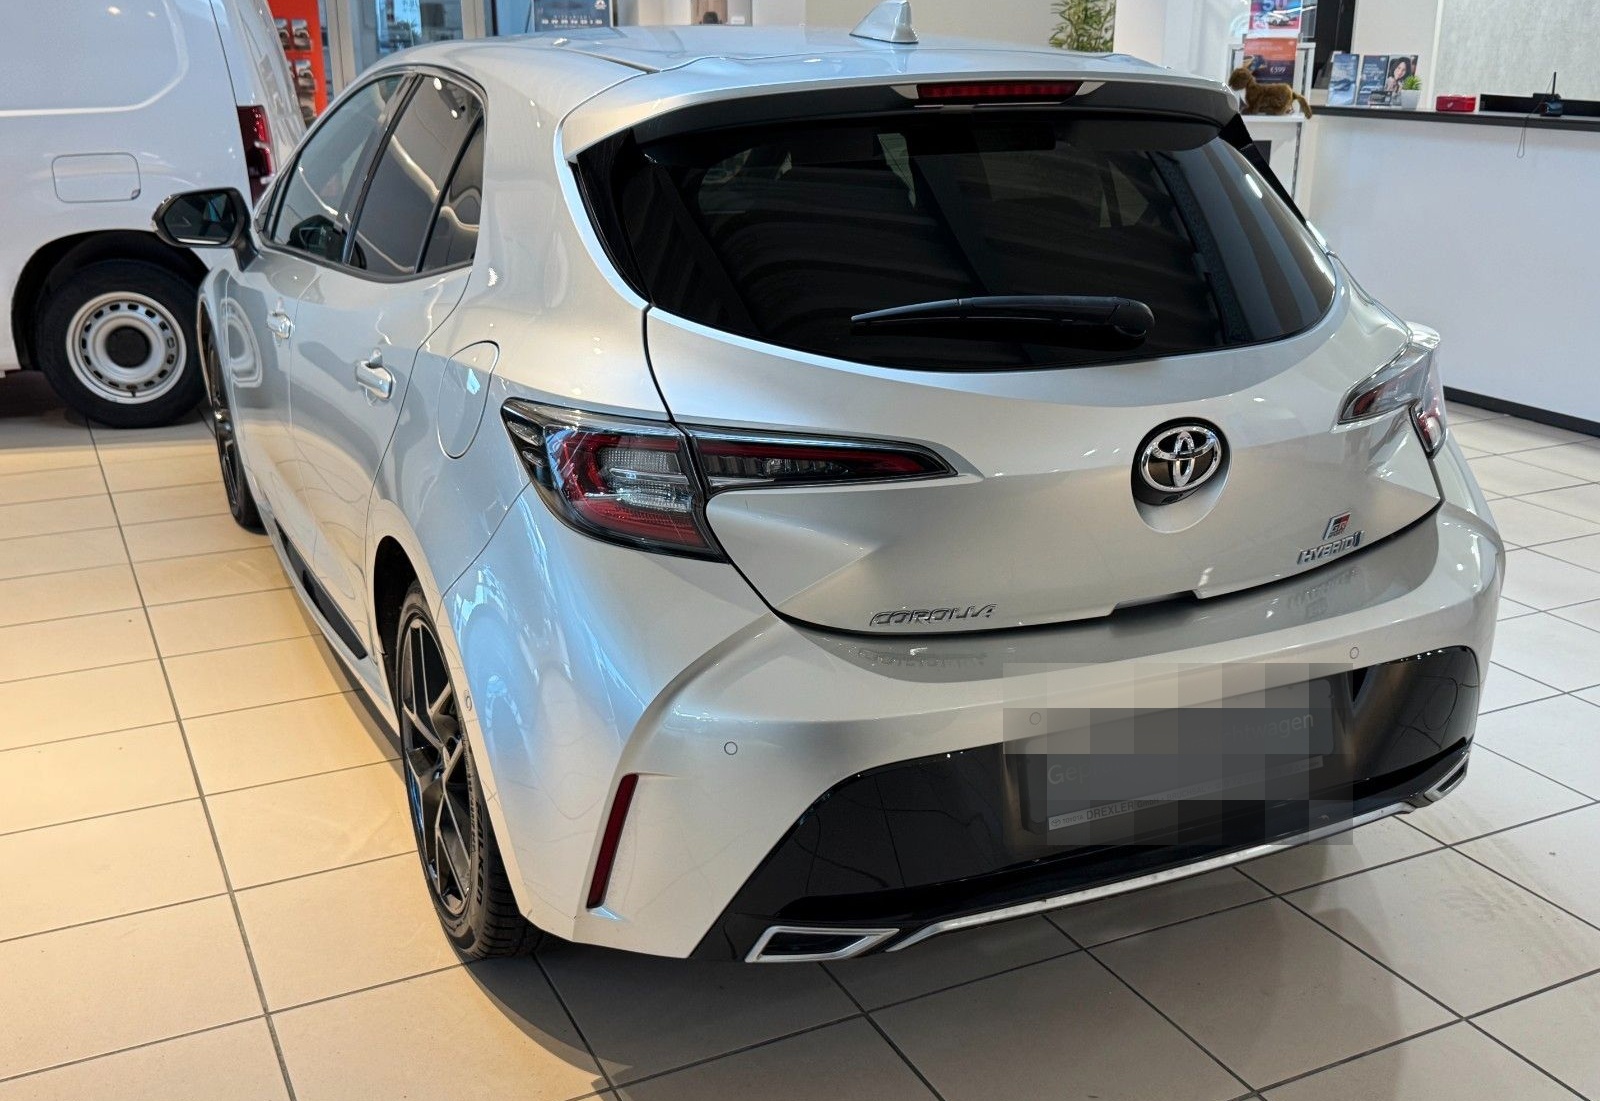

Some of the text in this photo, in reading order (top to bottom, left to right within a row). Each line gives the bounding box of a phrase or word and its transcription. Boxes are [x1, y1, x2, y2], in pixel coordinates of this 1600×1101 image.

[1297, 534, 1357, 566] HYBRID
[869, 603, 998, 627] COROLLA
[1086, 800, 1135, 820] DREXLER
[475, 801, 484, 905] FALKEN
